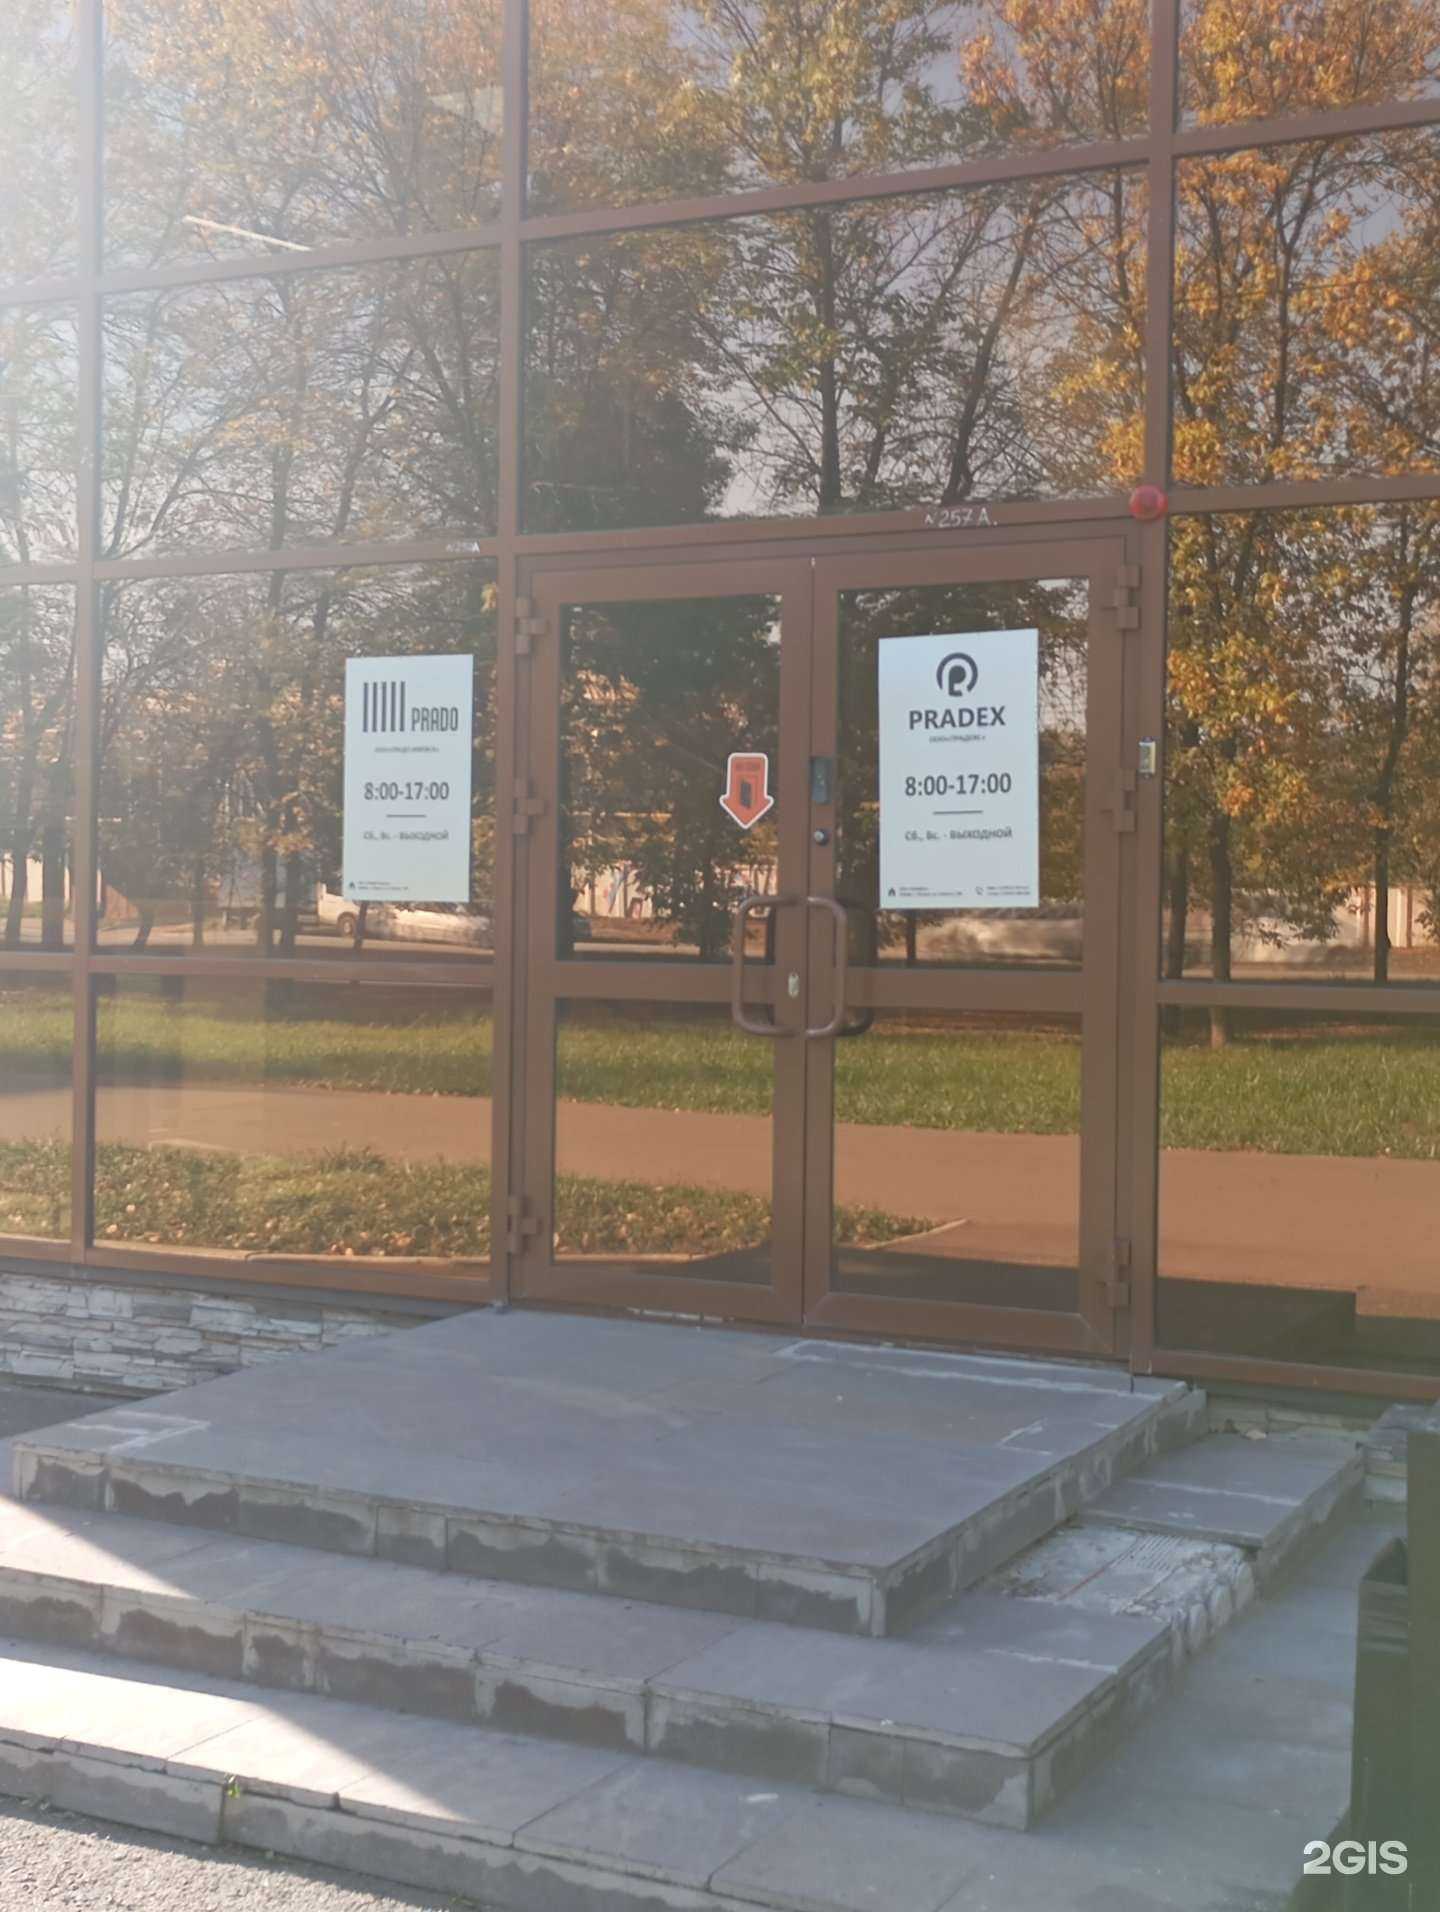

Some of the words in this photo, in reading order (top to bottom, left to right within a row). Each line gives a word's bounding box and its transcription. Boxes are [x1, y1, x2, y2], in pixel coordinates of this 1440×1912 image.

[939, 508, 973, 527] 257
[410, 706, 459, 732] PRADO
[908, 705, 1007, 730] PRADEX
[363, 781, 450, 801] 8:00-17:00
[904, 772, 1012, 797] 8:00-17:00
